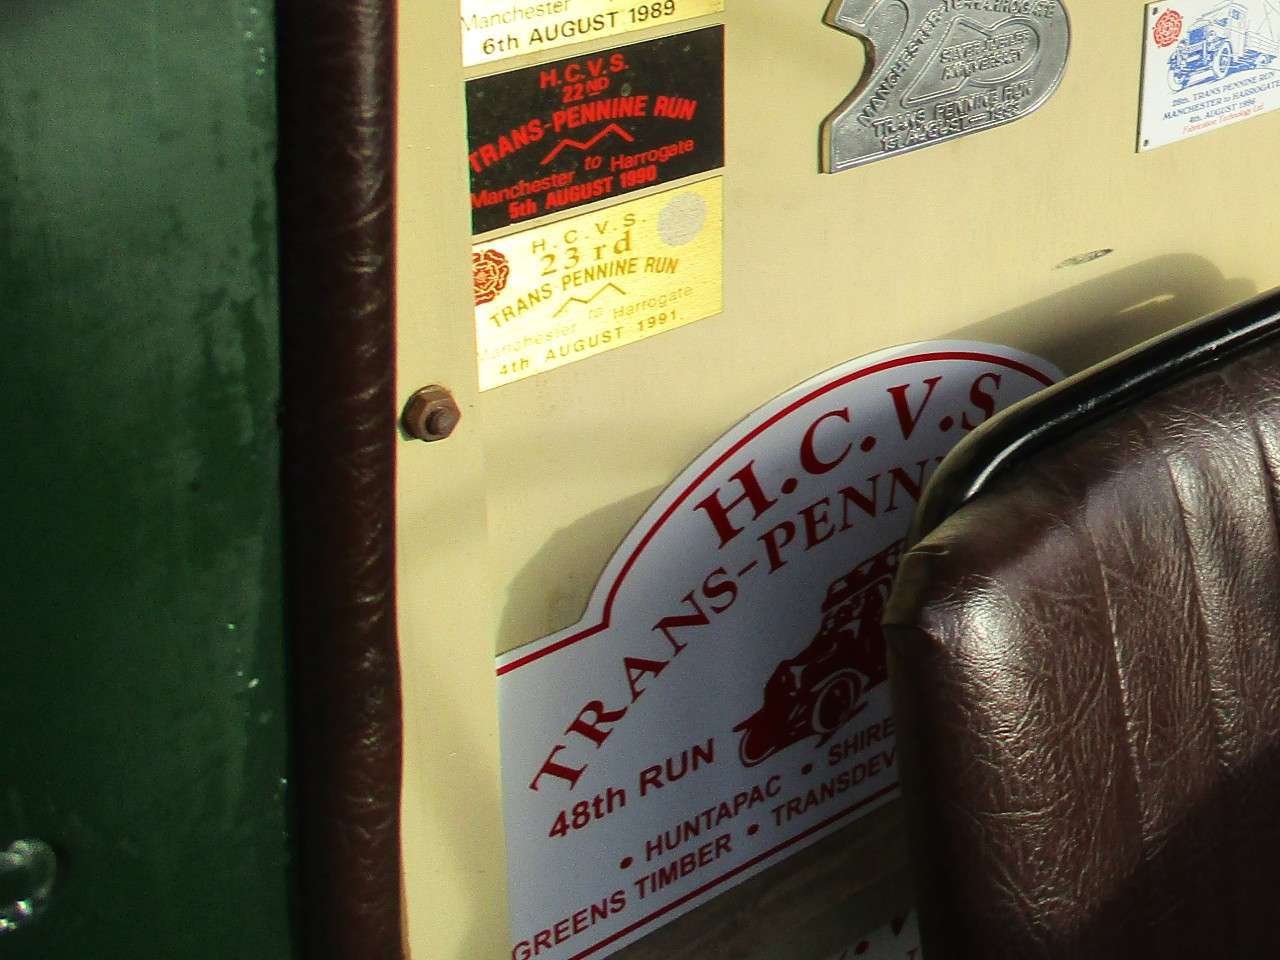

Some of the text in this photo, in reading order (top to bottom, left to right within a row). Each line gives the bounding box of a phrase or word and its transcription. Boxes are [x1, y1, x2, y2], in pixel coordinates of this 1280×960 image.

[482, 34, 519, 56] 6th
[528, 10, 619, 46] AUGUST
[539, 52, 630, 89] H.C.V.S.
[1193, 87, 1221, 101] TRANS
[468, 94, 697, 175] TRANS-PENNINE RUN
[470, 136, 696, 210] Manchester to Harrogate
[544, 175, 614, 211] AUGUST
[540, 229, 634, 278] 23rd
[644, 257, 680, 276] RUN
[612, 283, 695, 321] Harrogate
[499, 358, 530, 377] 4th
[545, 327, 624, 363] AUGUST
[530, 456, 946, 792] TRANS-PENN
[548, 739, 715, 839] 48th RUN
[644, 774, 783, 863] HUNTAPAC
[510, 747, 897, 960] GREENS TIMBER TRANSDEV
